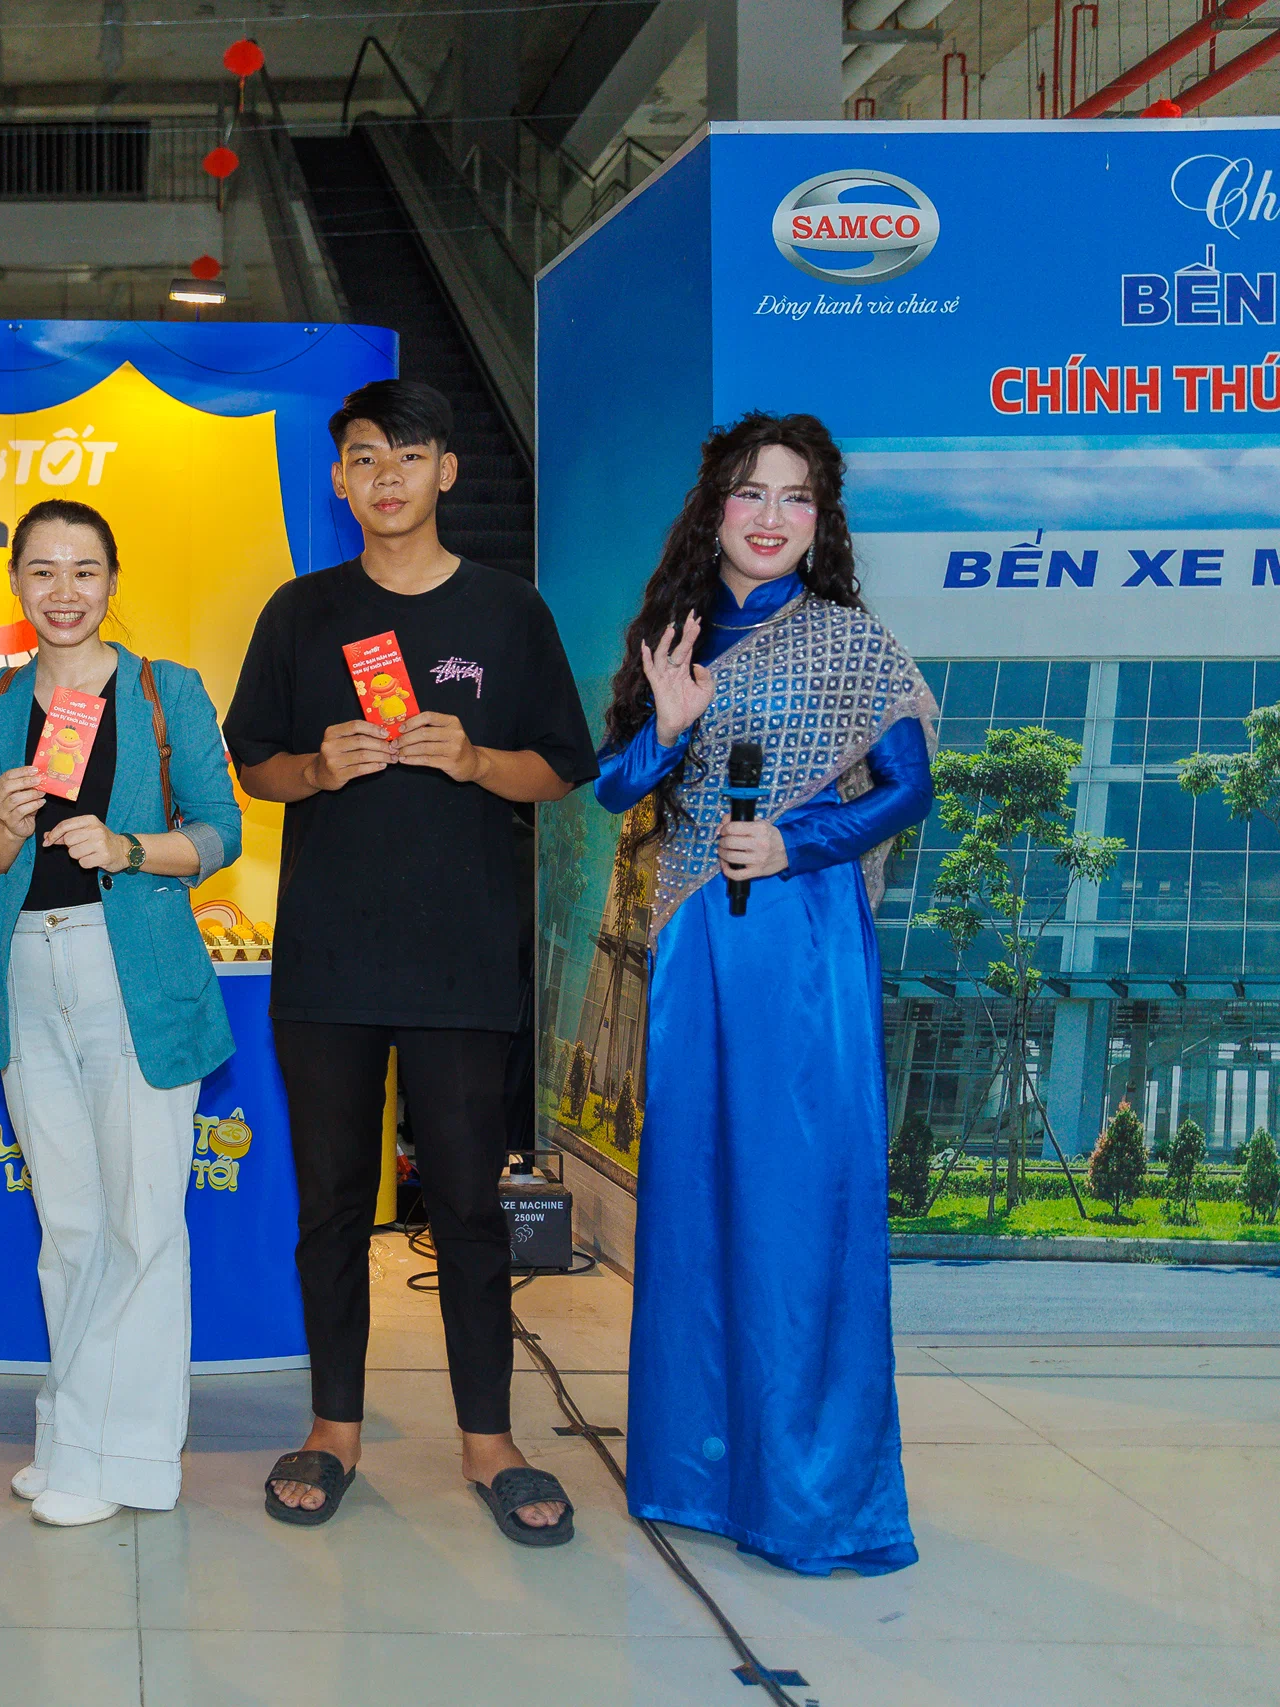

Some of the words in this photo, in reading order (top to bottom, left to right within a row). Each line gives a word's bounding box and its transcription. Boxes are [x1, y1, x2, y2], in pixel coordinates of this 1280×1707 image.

[792, 215, 920, 240] SAMCO
[1122, 244, 1276, 326] BẾN
[753, 295, 812, 320] Đồng
[814, 294, 863, 315] hành
[867, 296, 895, 314] và
[897, 293, 939, 314] chia
[990, 353, 1162, 415] CHÍNH
[942, 528, 1099, 589] BẾN
[1120, 548, 1225, 588] XE
[514, 1214, 544, 1222] 2500W
[520, 1201, 564, 1210] MACHINE
